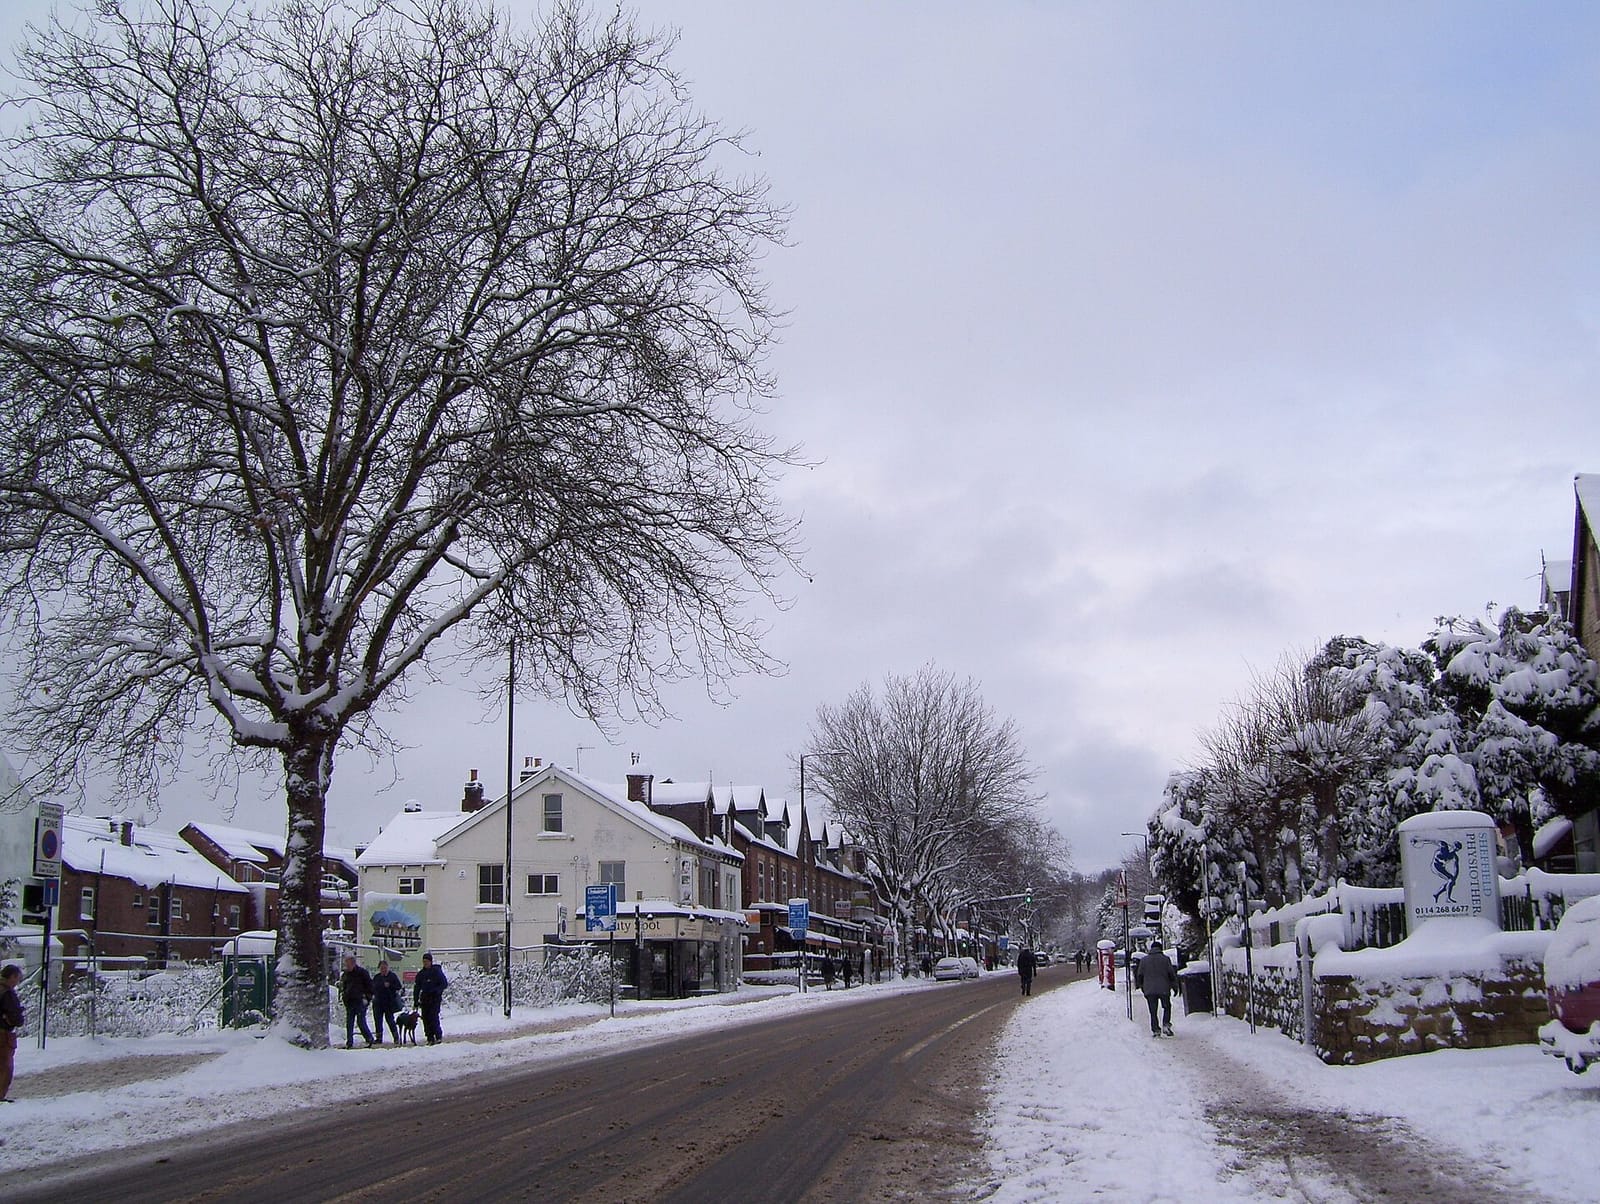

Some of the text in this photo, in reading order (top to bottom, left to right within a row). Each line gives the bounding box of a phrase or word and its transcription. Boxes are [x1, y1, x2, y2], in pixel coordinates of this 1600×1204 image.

[43, 819, 58, 829] ZONE
[1466, 833, 1481, 917] PHYSIOTHER
[1478, 832, 1492, 897] SHEFFIELD
[1415, 905, 1469, 915] 0114 268 6677
